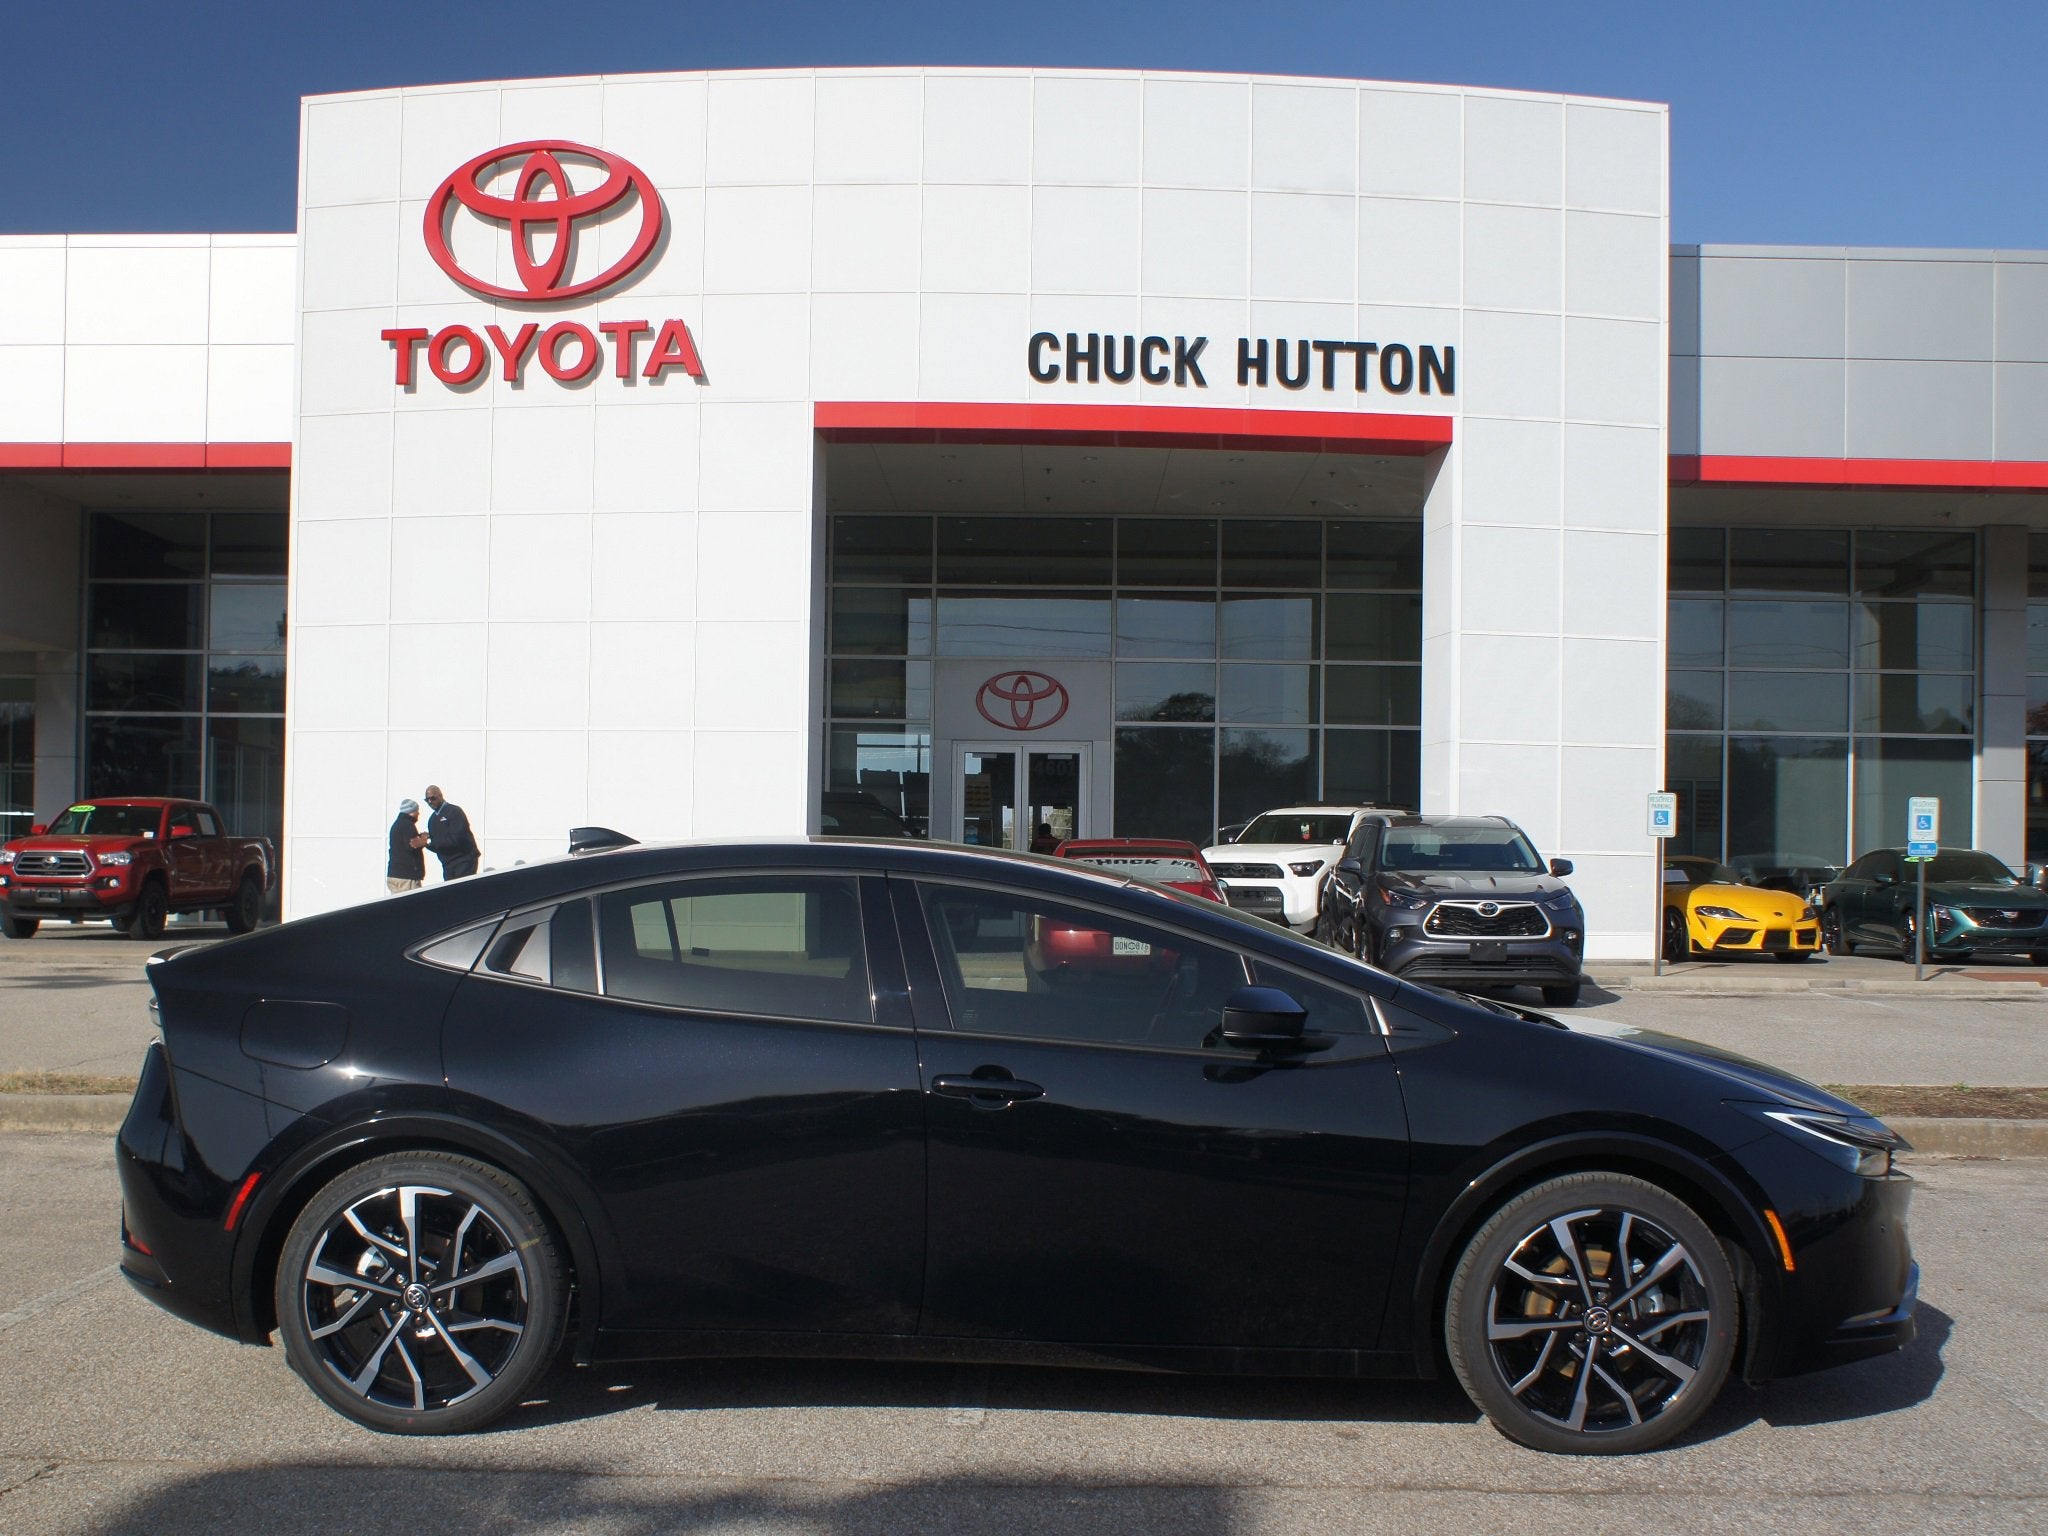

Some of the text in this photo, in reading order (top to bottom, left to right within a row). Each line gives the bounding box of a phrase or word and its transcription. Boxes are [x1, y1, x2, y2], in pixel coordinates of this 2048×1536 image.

[381, 319, 702, 387] TOYOTA
[1028, 332, 1455, 395] CHUCK HUTTON
